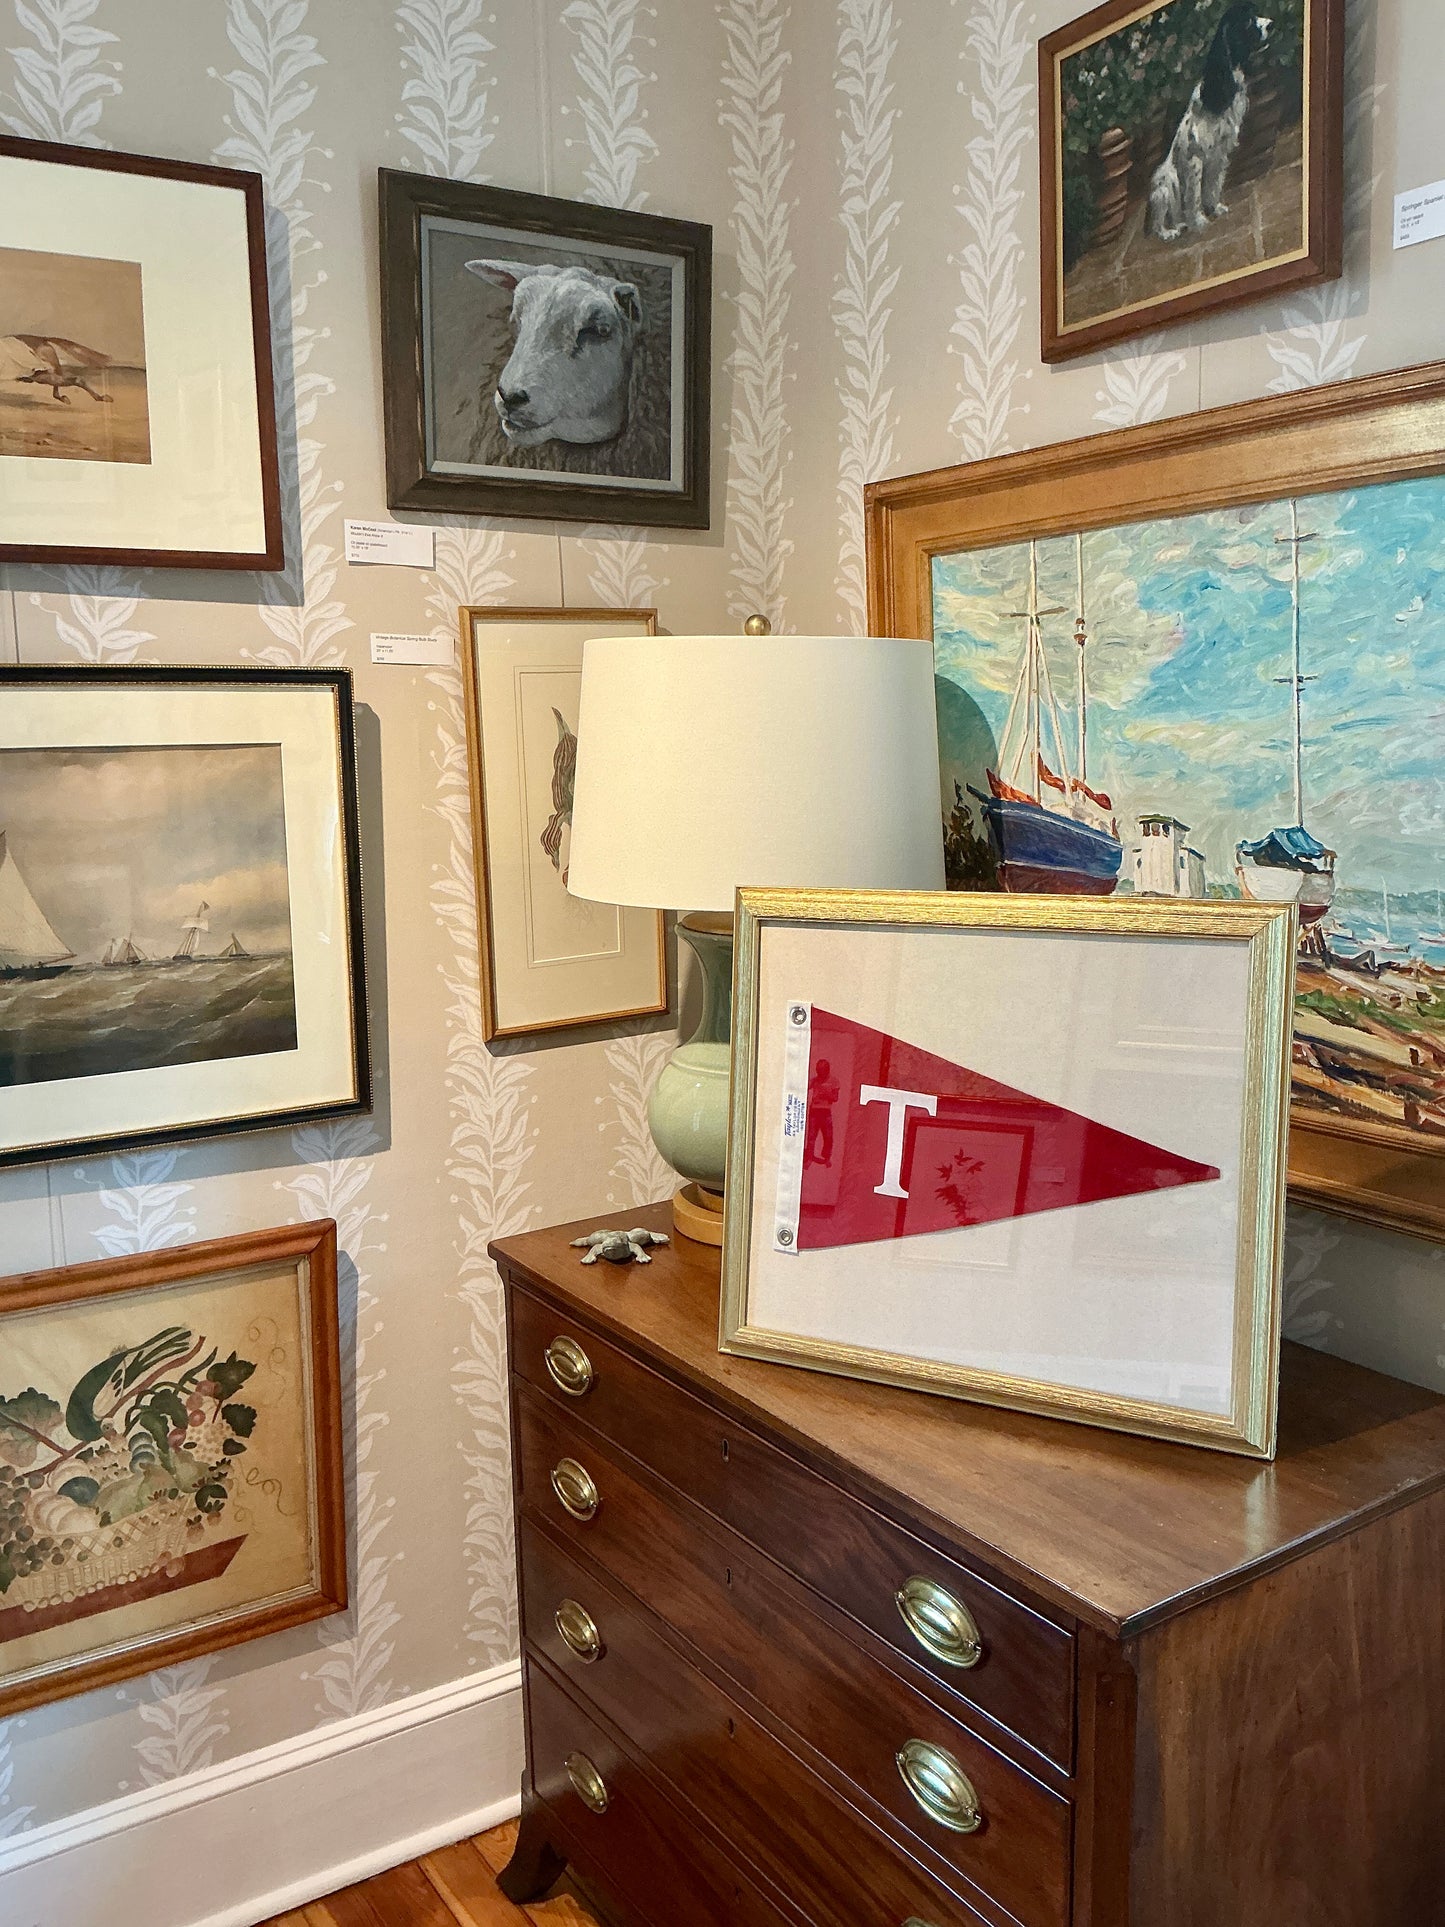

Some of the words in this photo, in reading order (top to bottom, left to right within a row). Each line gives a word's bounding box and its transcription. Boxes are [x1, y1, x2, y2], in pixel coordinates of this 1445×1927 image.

[1401, 201, 1423, 213] Springer
[784, 1112, 793, 1137] Taylor
[860, 1084, 938, 1199] T
